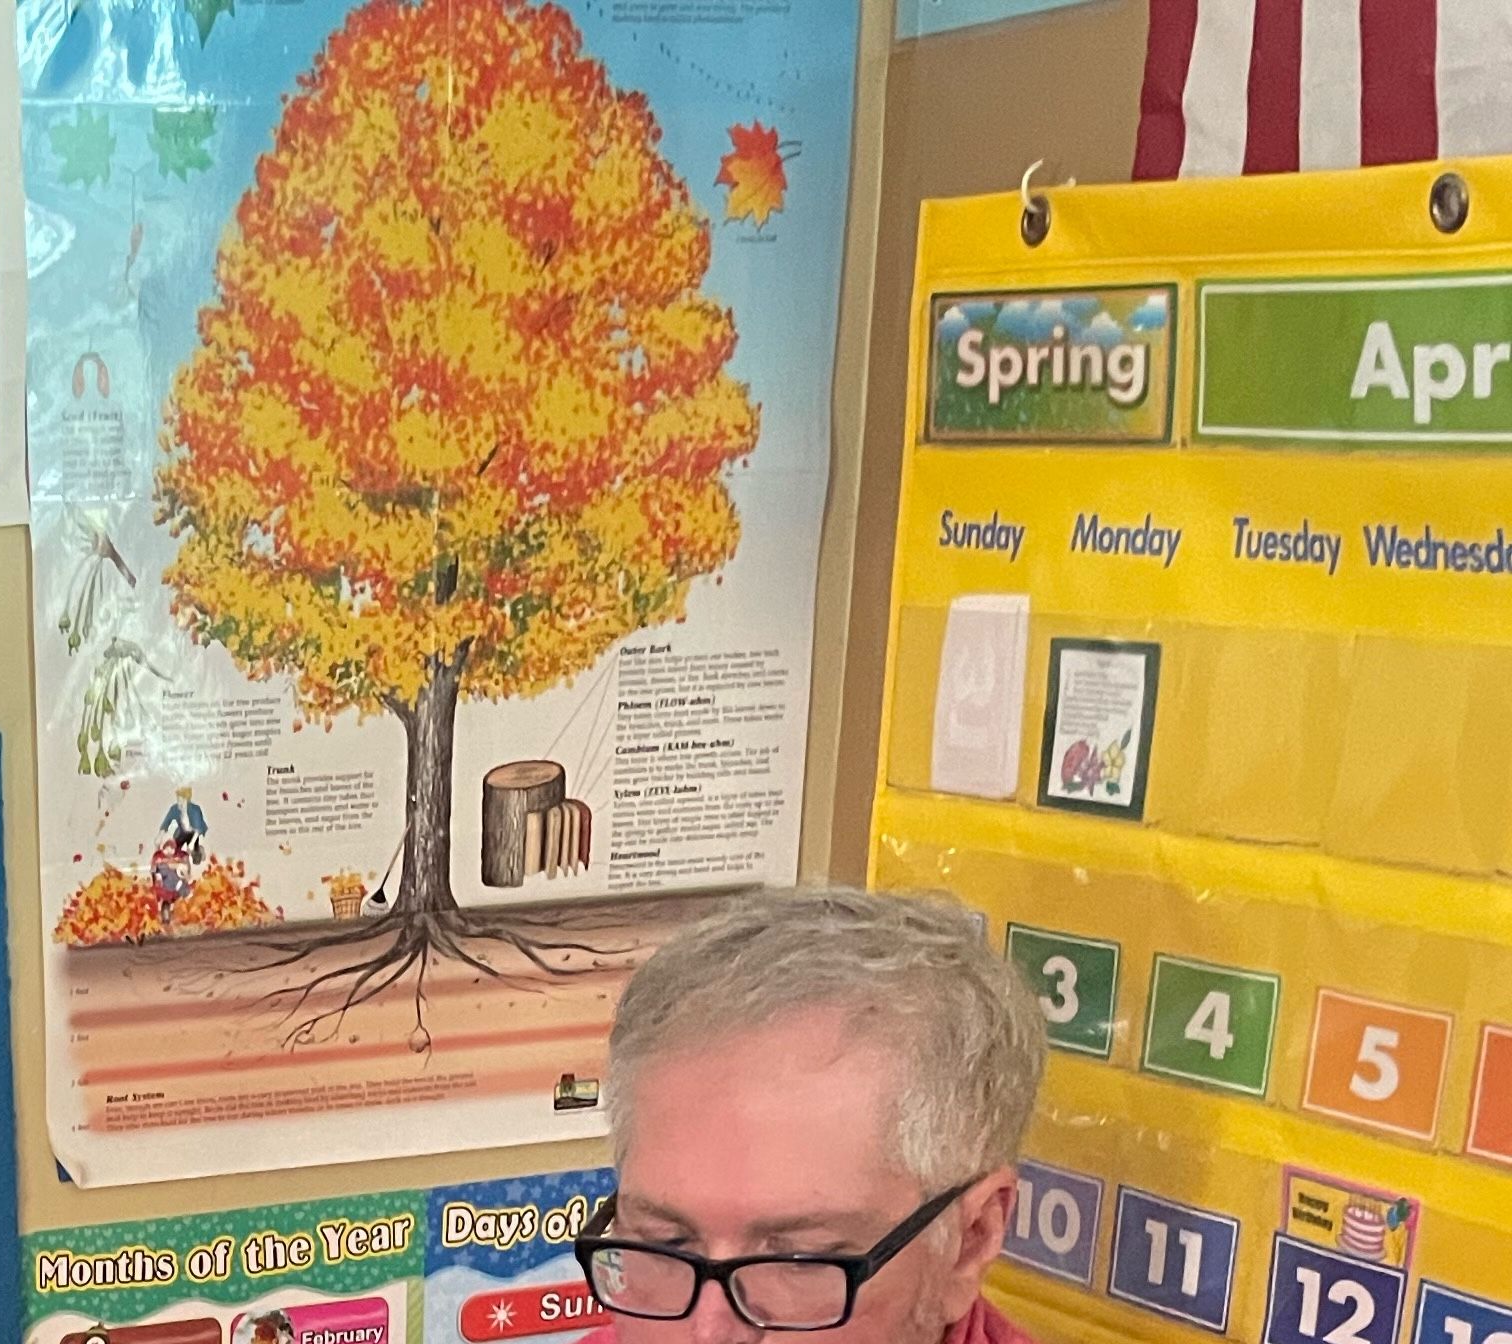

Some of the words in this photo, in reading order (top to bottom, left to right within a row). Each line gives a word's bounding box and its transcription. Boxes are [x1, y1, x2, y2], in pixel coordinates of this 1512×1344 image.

[954, 324, 1149, 406] Spring
[1349, 319, 1512, 426] Apr
[938, 509, 1026, 564] Sunday
[1069, 511, 1183, 570] Monday
[1232, 516, 1342, 576] Tuesday
[266, 763, 296, 776] Trunk
[1037, 954, 1079, 1025] 3
[1182, 989, 1235, 1062] 4
[1348, 1024, 1401, 1102] 5
[39, 1250, 175, 1289] Months
[187, 1240, 232, 1279] of
[244, 1233, 312, 1274] the
[319, 1216, 412, 1261] Year
[444, 1206, 535, 1247] Days
[545, 1199, 585, 1239] of
[1014, 1177, 1081, 1256] 10
[1143, 1218, 1204, 1299] 11
